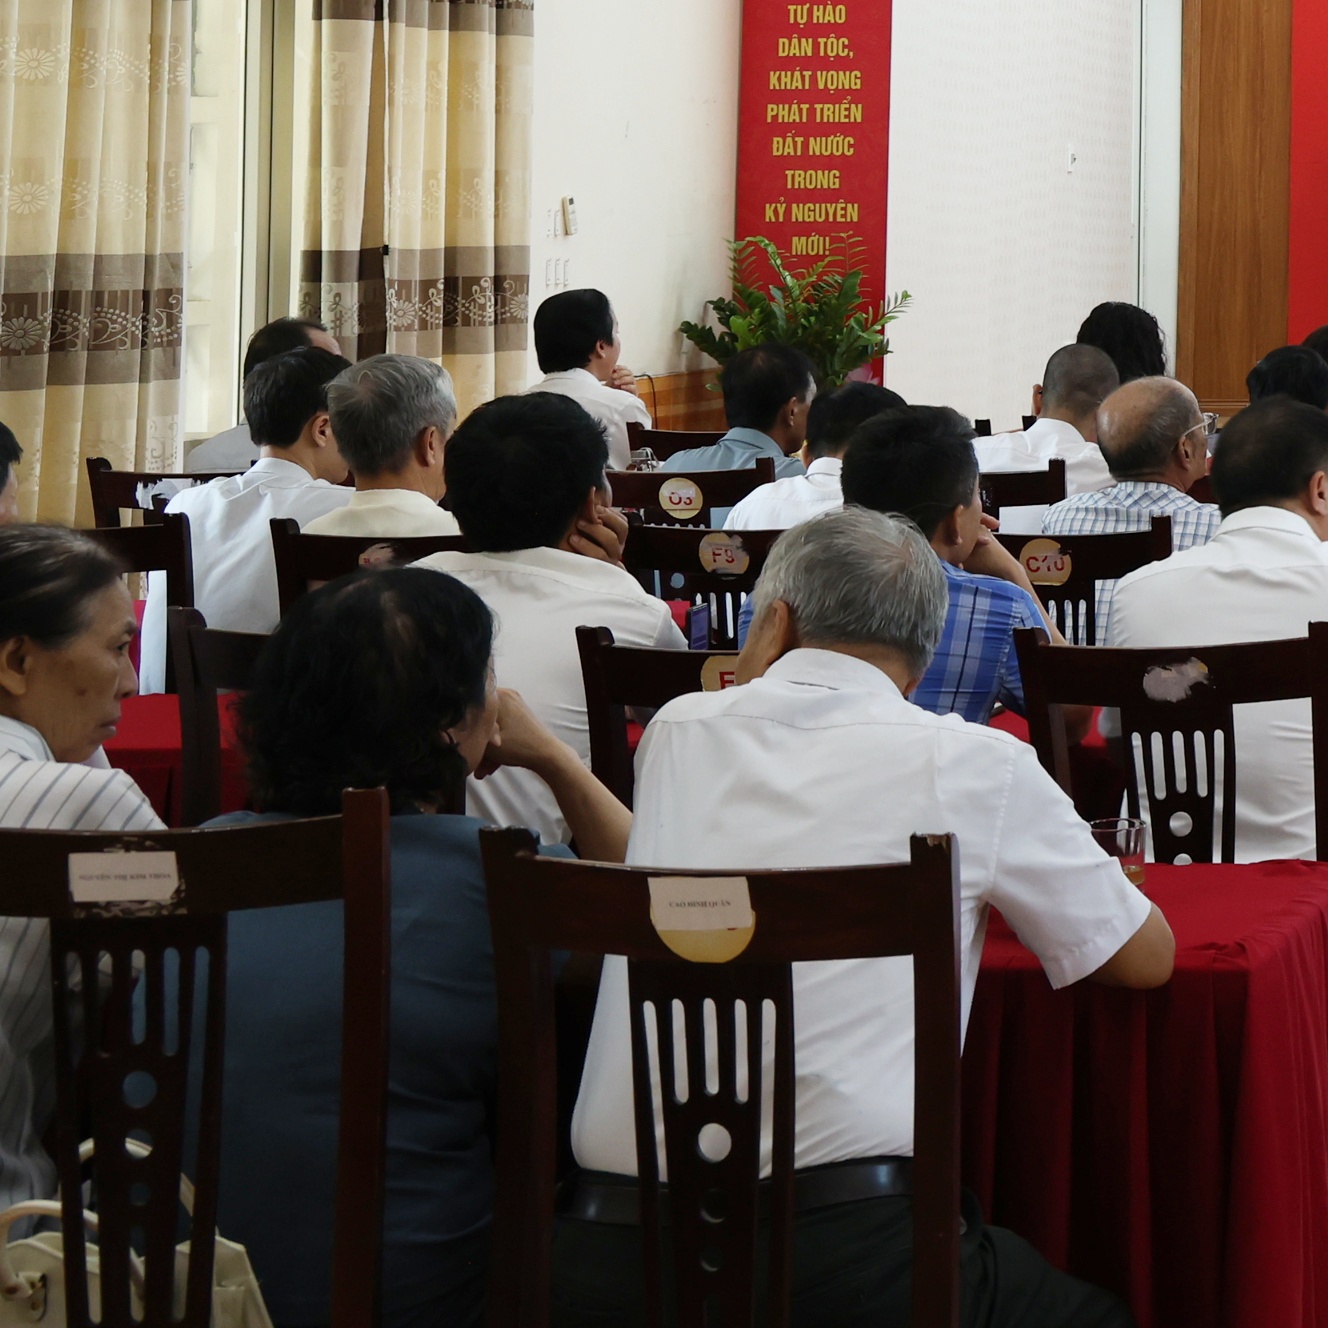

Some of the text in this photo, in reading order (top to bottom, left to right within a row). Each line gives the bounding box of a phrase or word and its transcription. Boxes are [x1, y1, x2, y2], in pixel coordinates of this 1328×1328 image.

[788, 1, 846, 27] TỰ HÀO
[779, 34, 853, 60] DÂN TỘC,
[770, 67, 861, 93] KHÁT VỌNG
[767, 96, 862, 122] PHÁT TRIỂN
[773, 130, 854, 155] ĐẤT NƯỚC
[786, 170, 840, 188] TRONG
[766, 197, 858, 222] KỶ NGUYÊN
[792, 233, 830, 255] MỚI!
